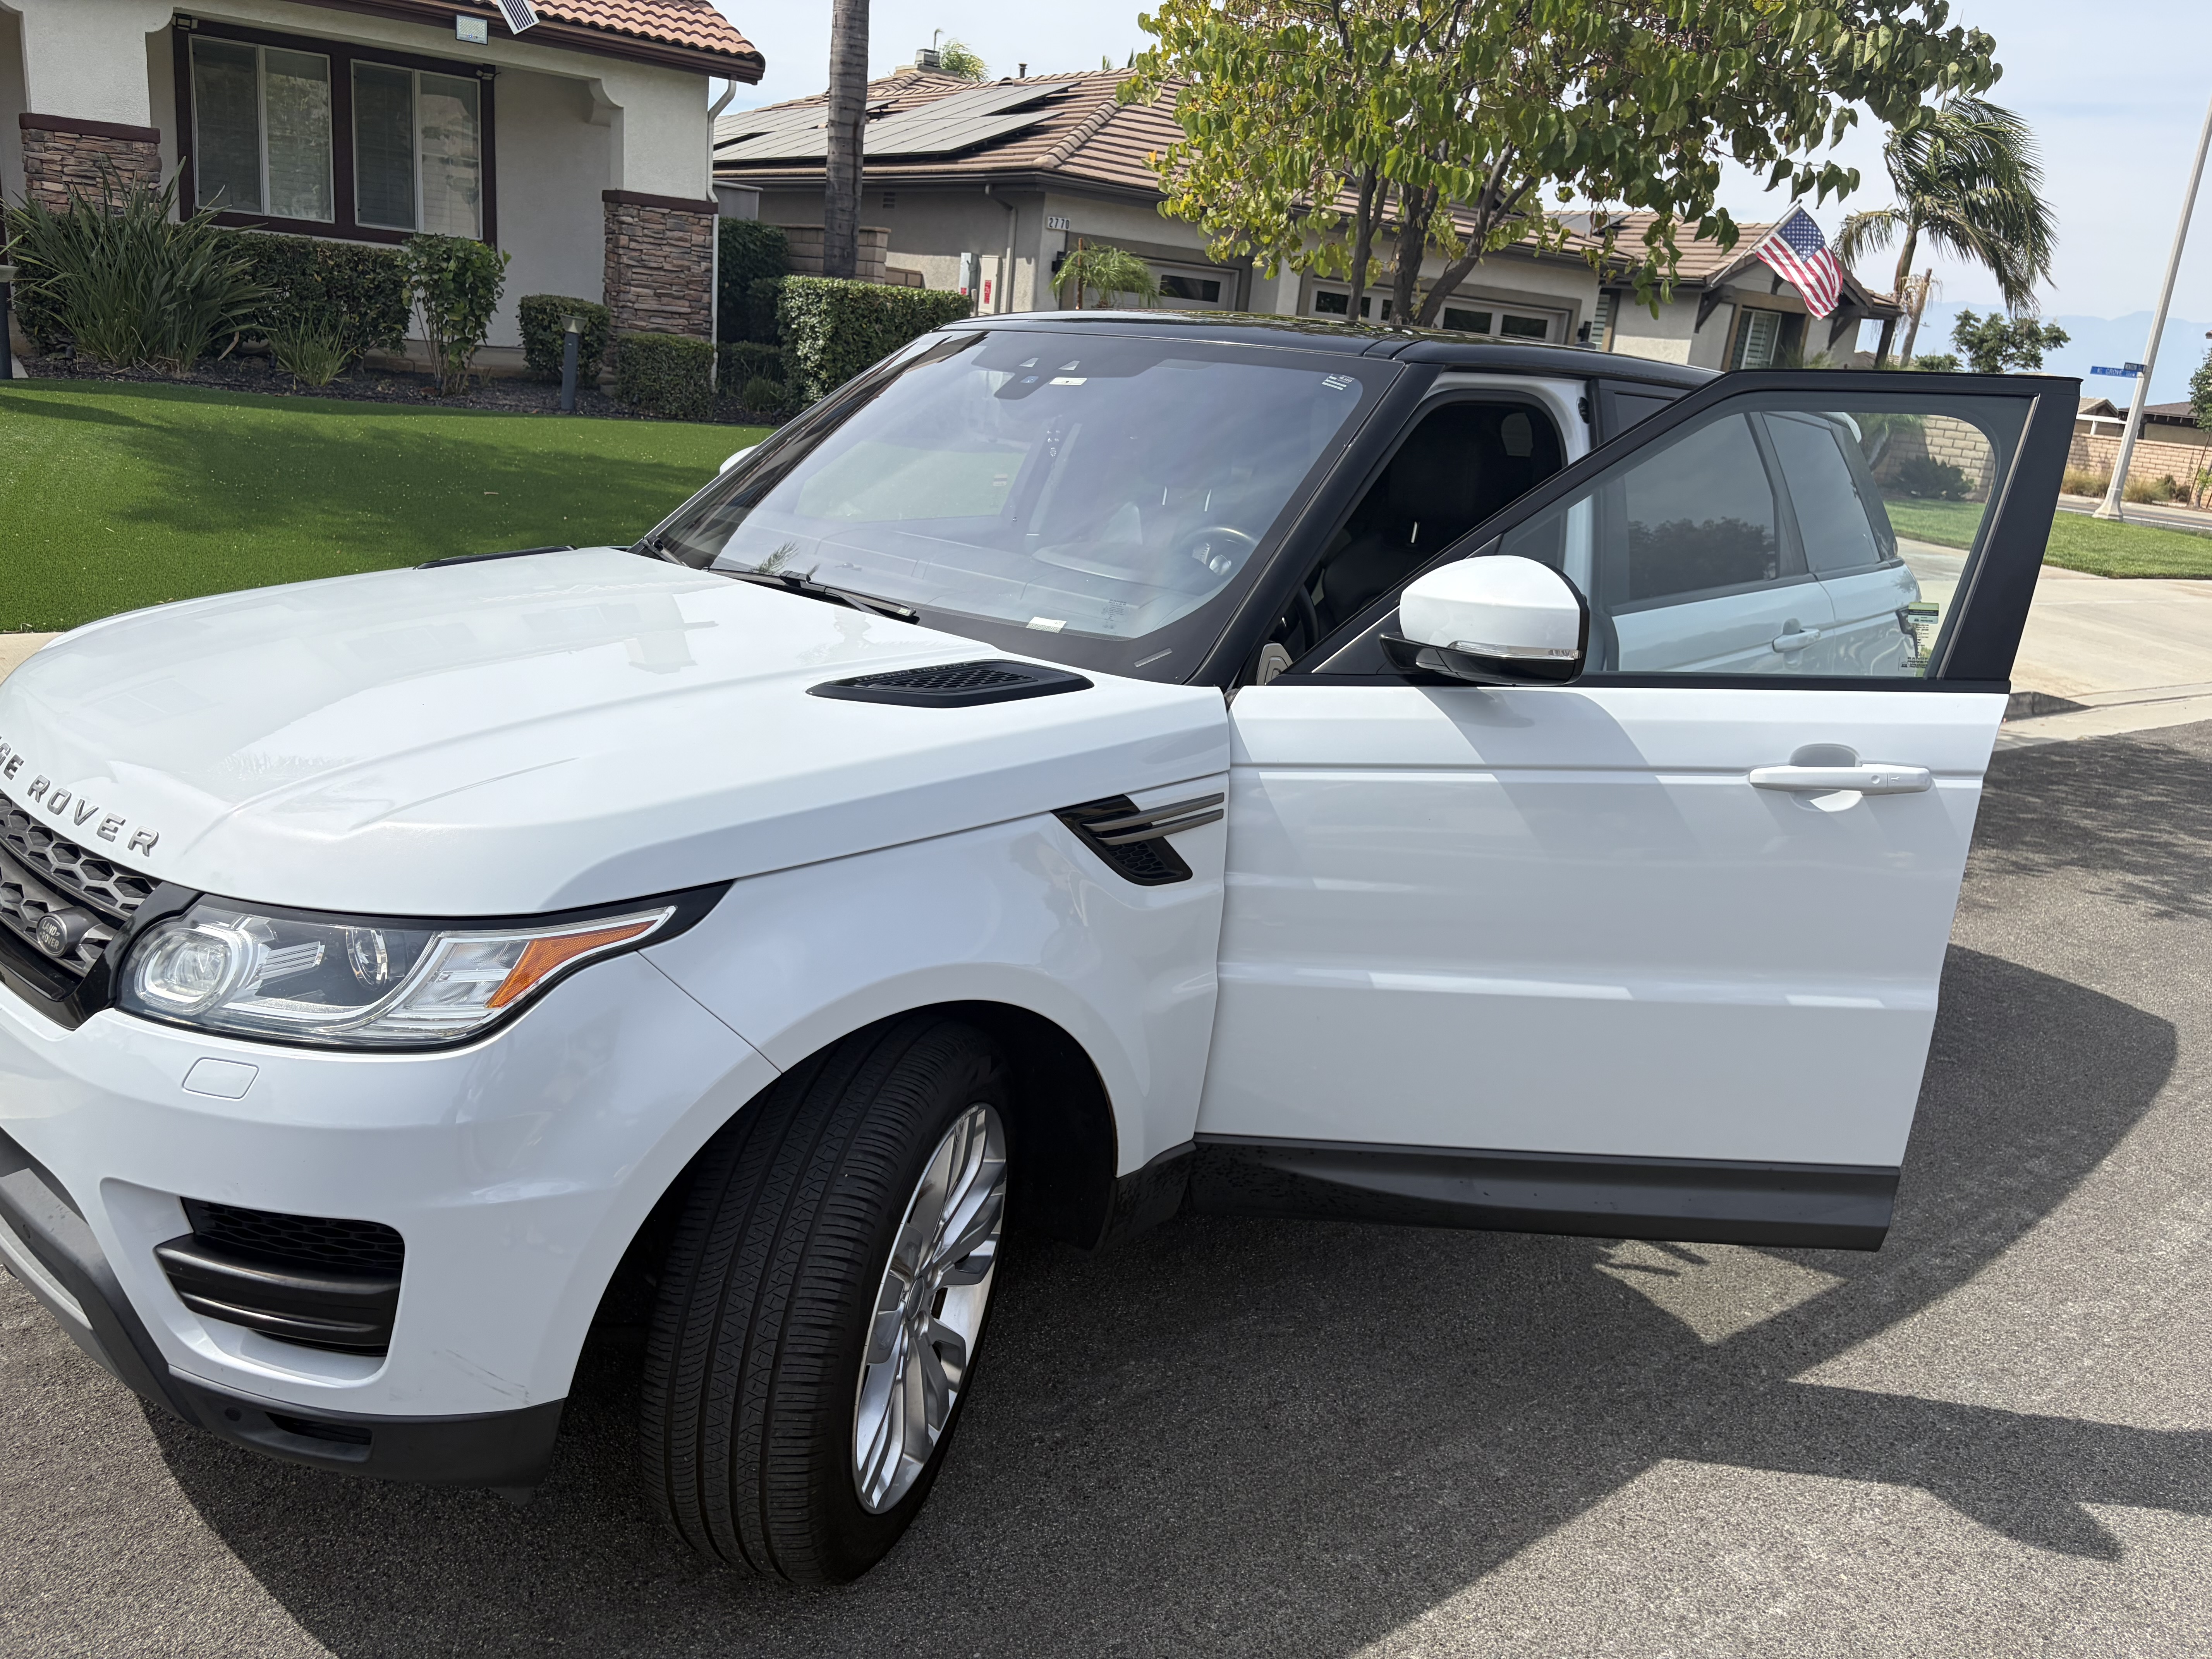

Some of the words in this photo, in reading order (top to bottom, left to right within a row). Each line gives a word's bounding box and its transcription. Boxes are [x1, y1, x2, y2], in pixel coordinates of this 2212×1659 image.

[1049, 217, 1070, 229] 2770
[0, 736, 24, 780] GE
[27, 775, 159, 857] ROVER
[42, 920, 57, 936] LAND
[41, 931, 59, 950] ROVER
